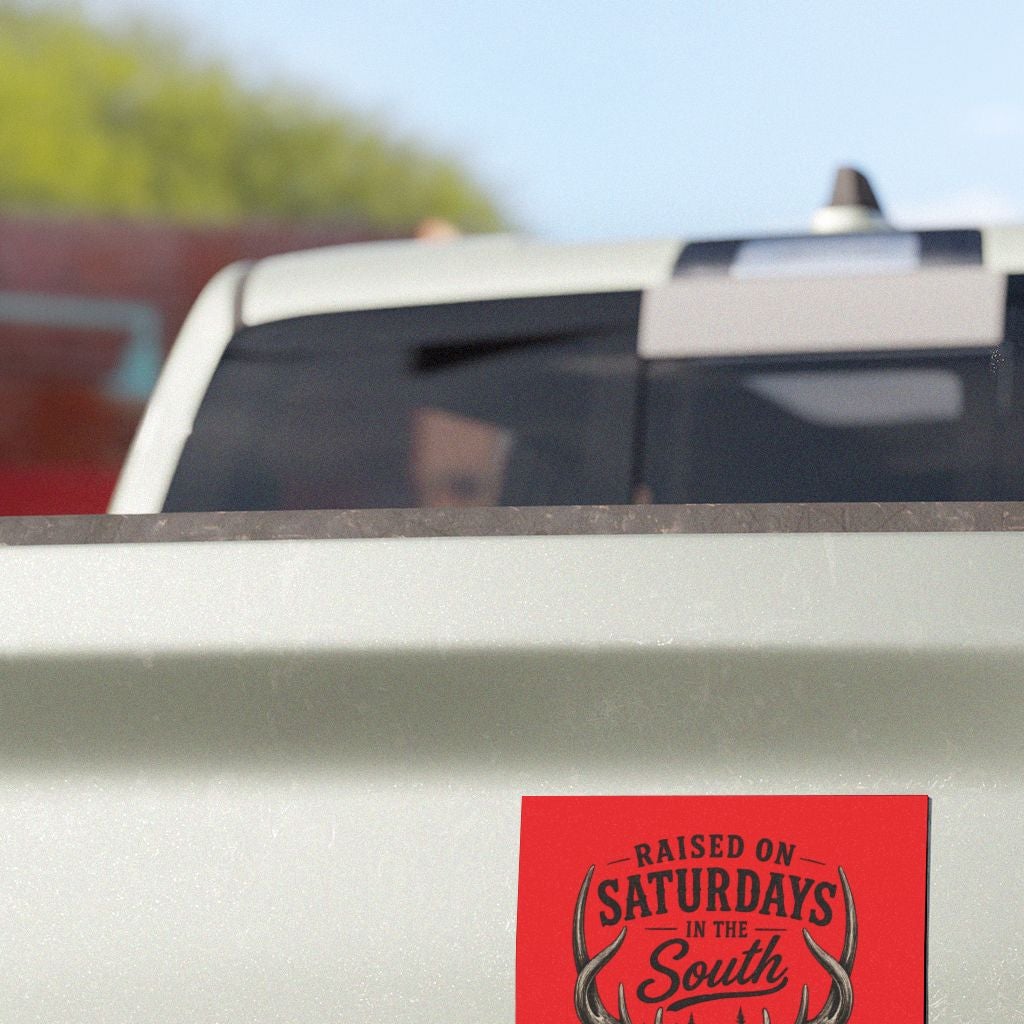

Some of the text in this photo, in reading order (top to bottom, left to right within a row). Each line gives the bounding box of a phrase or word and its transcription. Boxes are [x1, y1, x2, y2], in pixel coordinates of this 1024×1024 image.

[633, 834, 796, 867] RAISED ON
[597, 867, 837, 927] SATURDAYS
[686, 920, 748, 938] IN THE
[636, 935, 789, 1004] South
